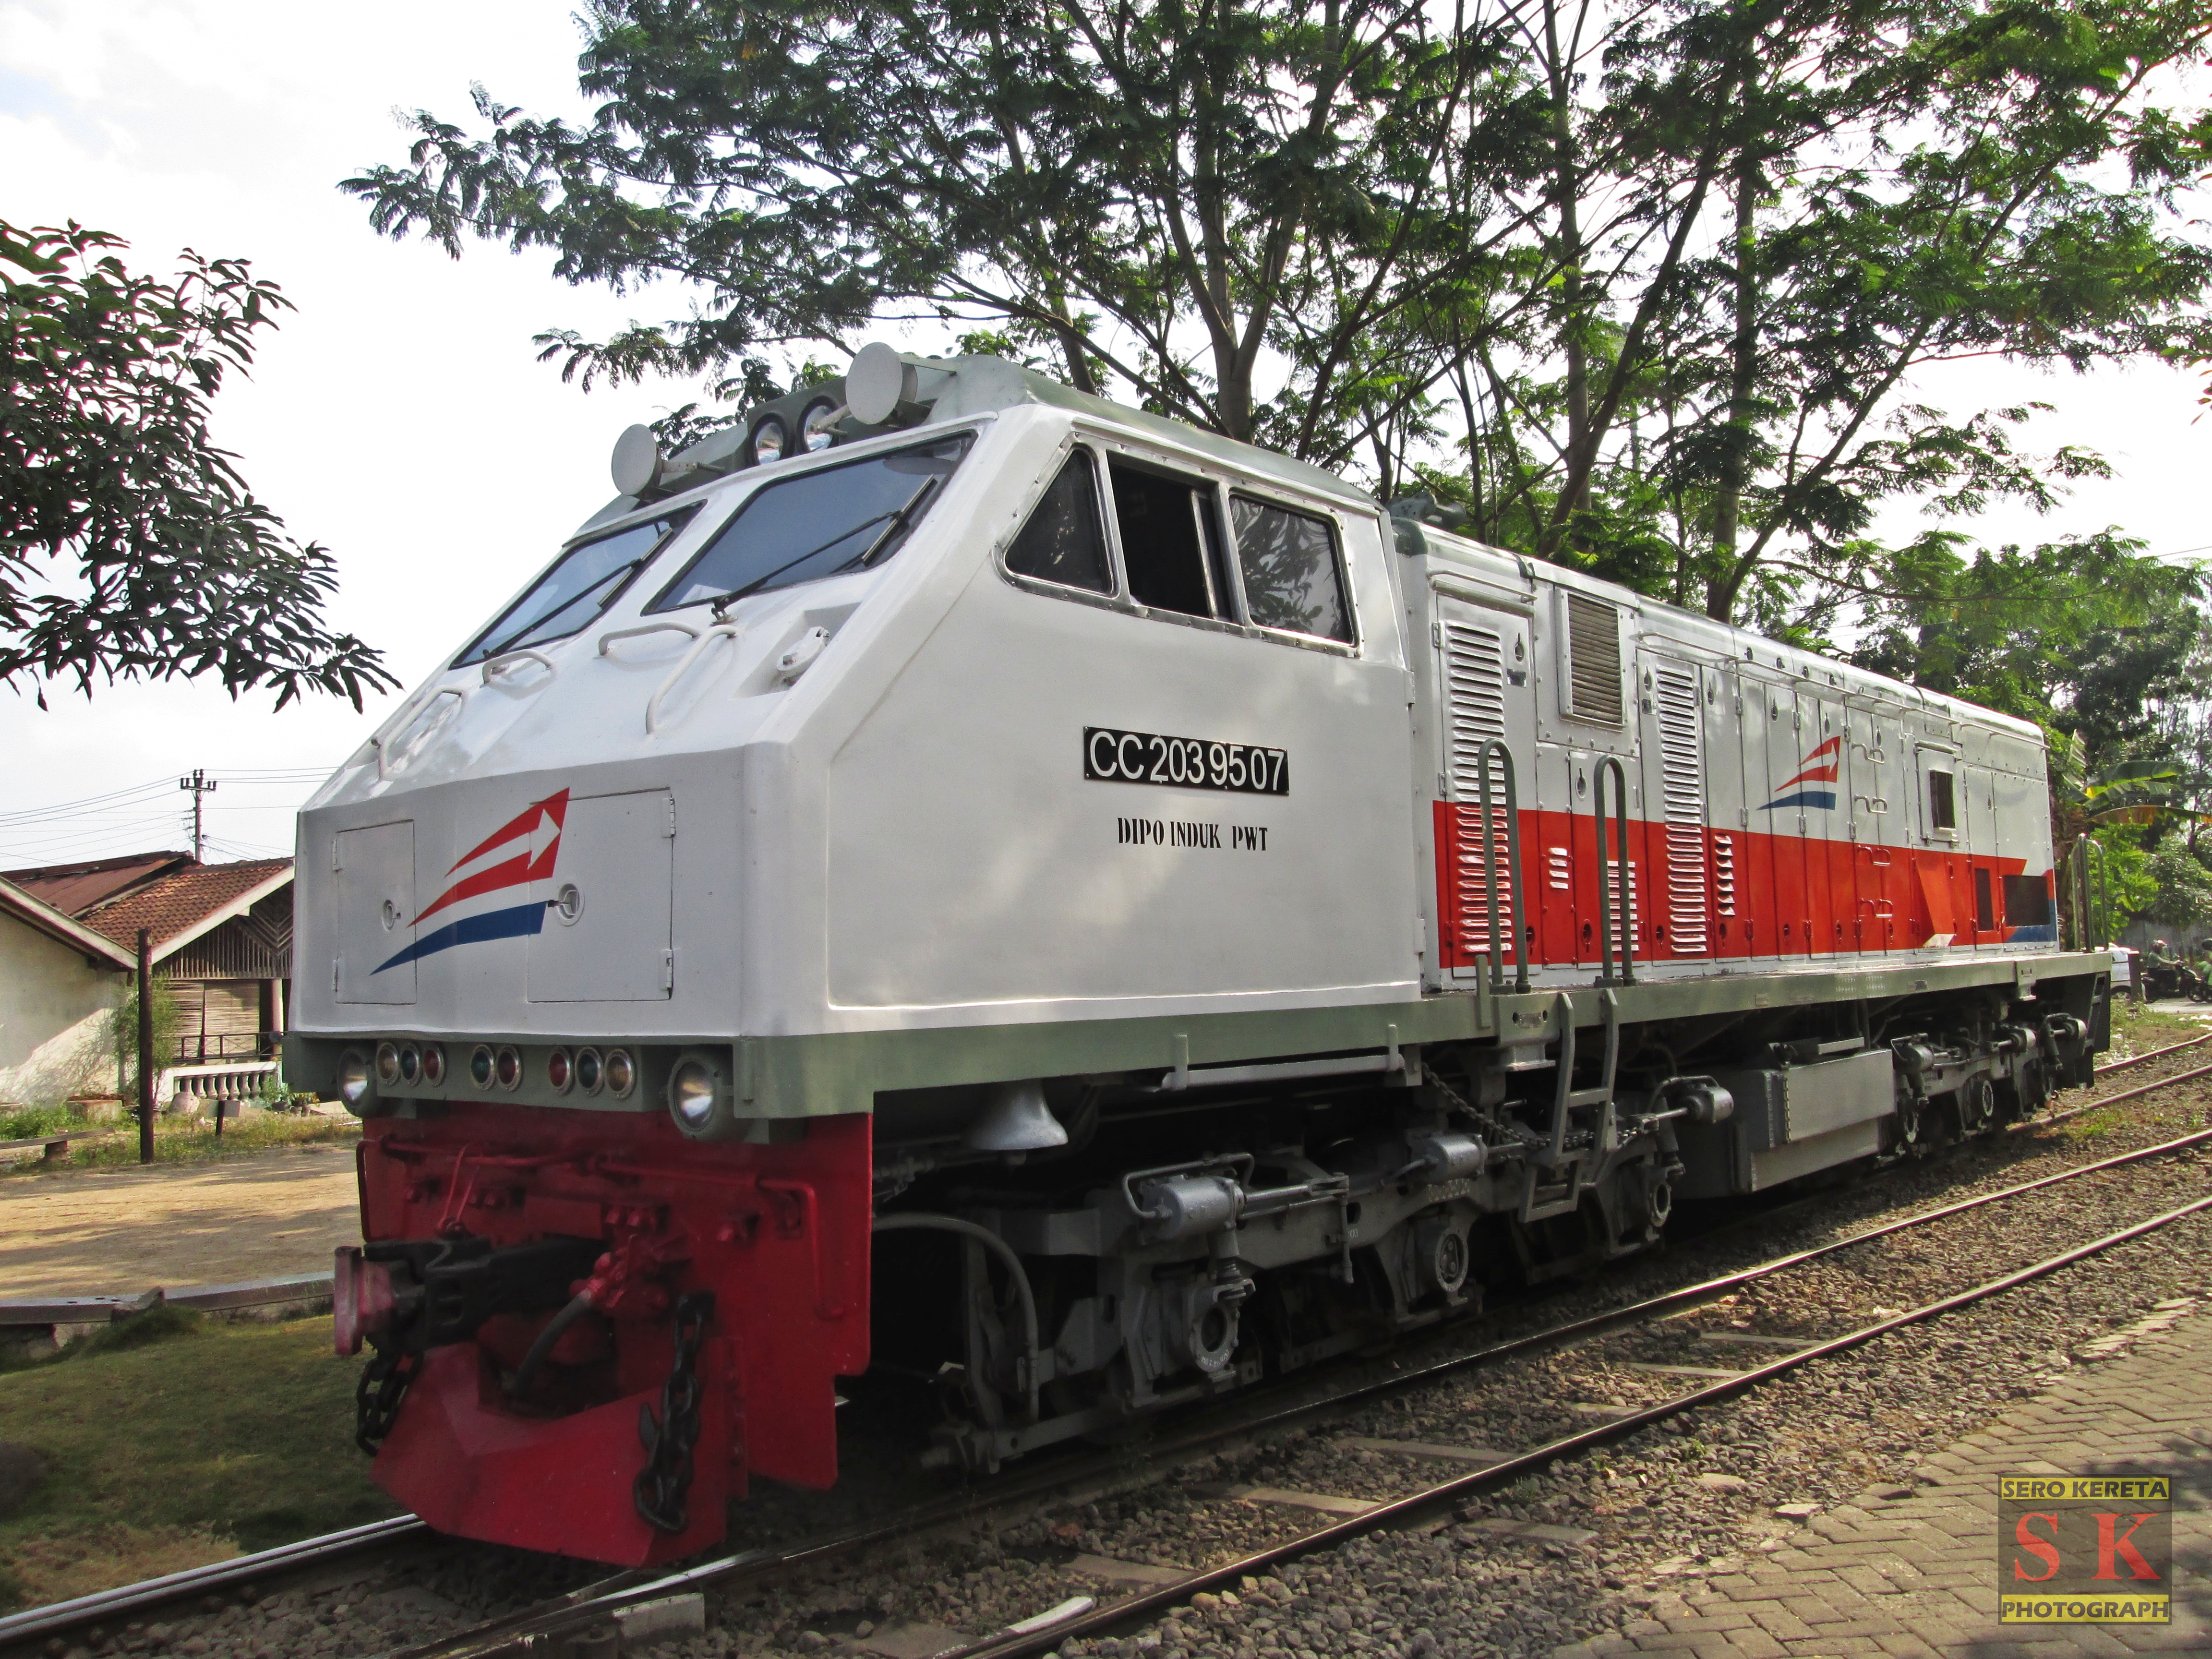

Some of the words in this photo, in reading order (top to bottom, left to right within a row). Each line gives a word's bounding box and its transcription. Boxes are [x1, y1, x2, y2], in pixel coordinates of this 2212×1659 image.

[1117, 817, 1165, 845] DIPO
[1170, 821, 1222, 849] INDUK
[1232, 826, 1268, 851] PWT
